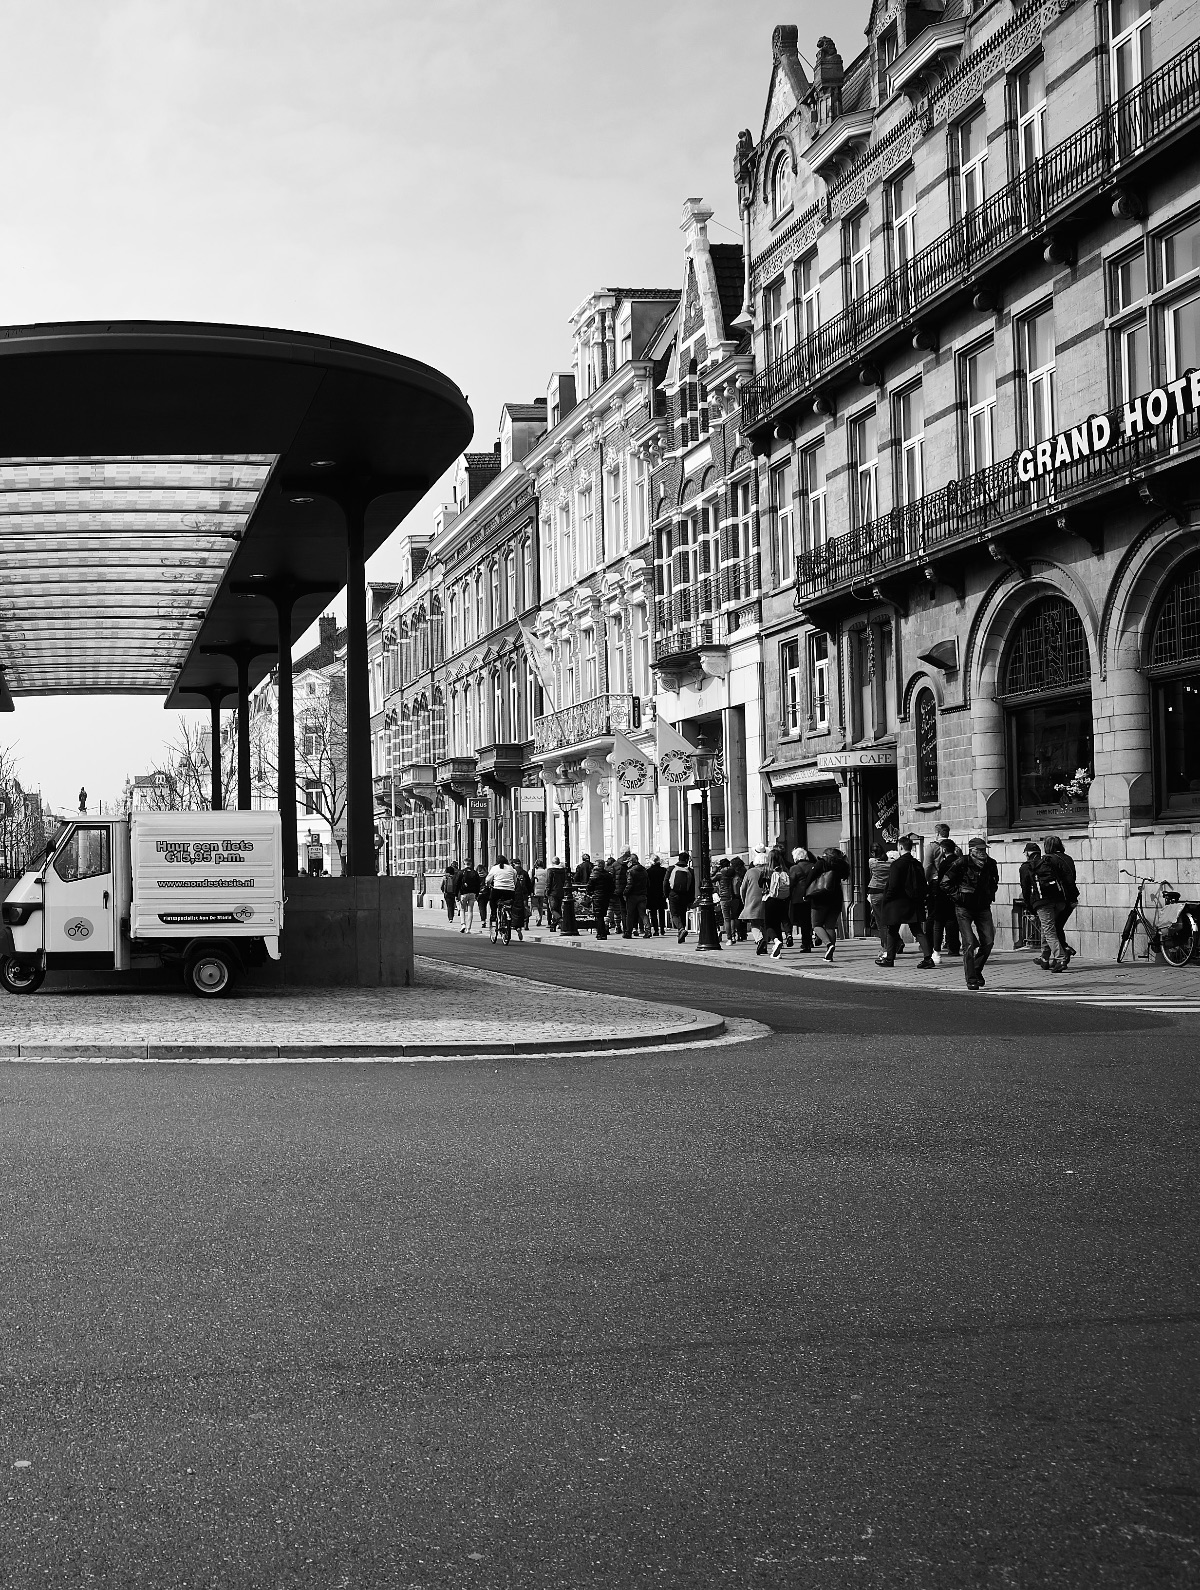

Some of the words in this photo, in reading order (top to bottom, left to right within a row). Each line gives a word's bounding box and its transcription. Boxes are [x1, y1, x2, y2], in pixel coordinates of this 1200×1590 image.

[1017, 415, 1111, 482] GRAND
[859, 753, 892, 764] CAFE
[876, 789, 896, 809] HOTEL
[156, 840, 190, 852] Huur
[192, 842, 219, 852] een
[222, 840, 254, 851] fiets
[165, 851, 212, 865] €15,95
[214, 853, 245, 864] p.m.
[157, 879, 255, 888] www.aondestasie.nl
